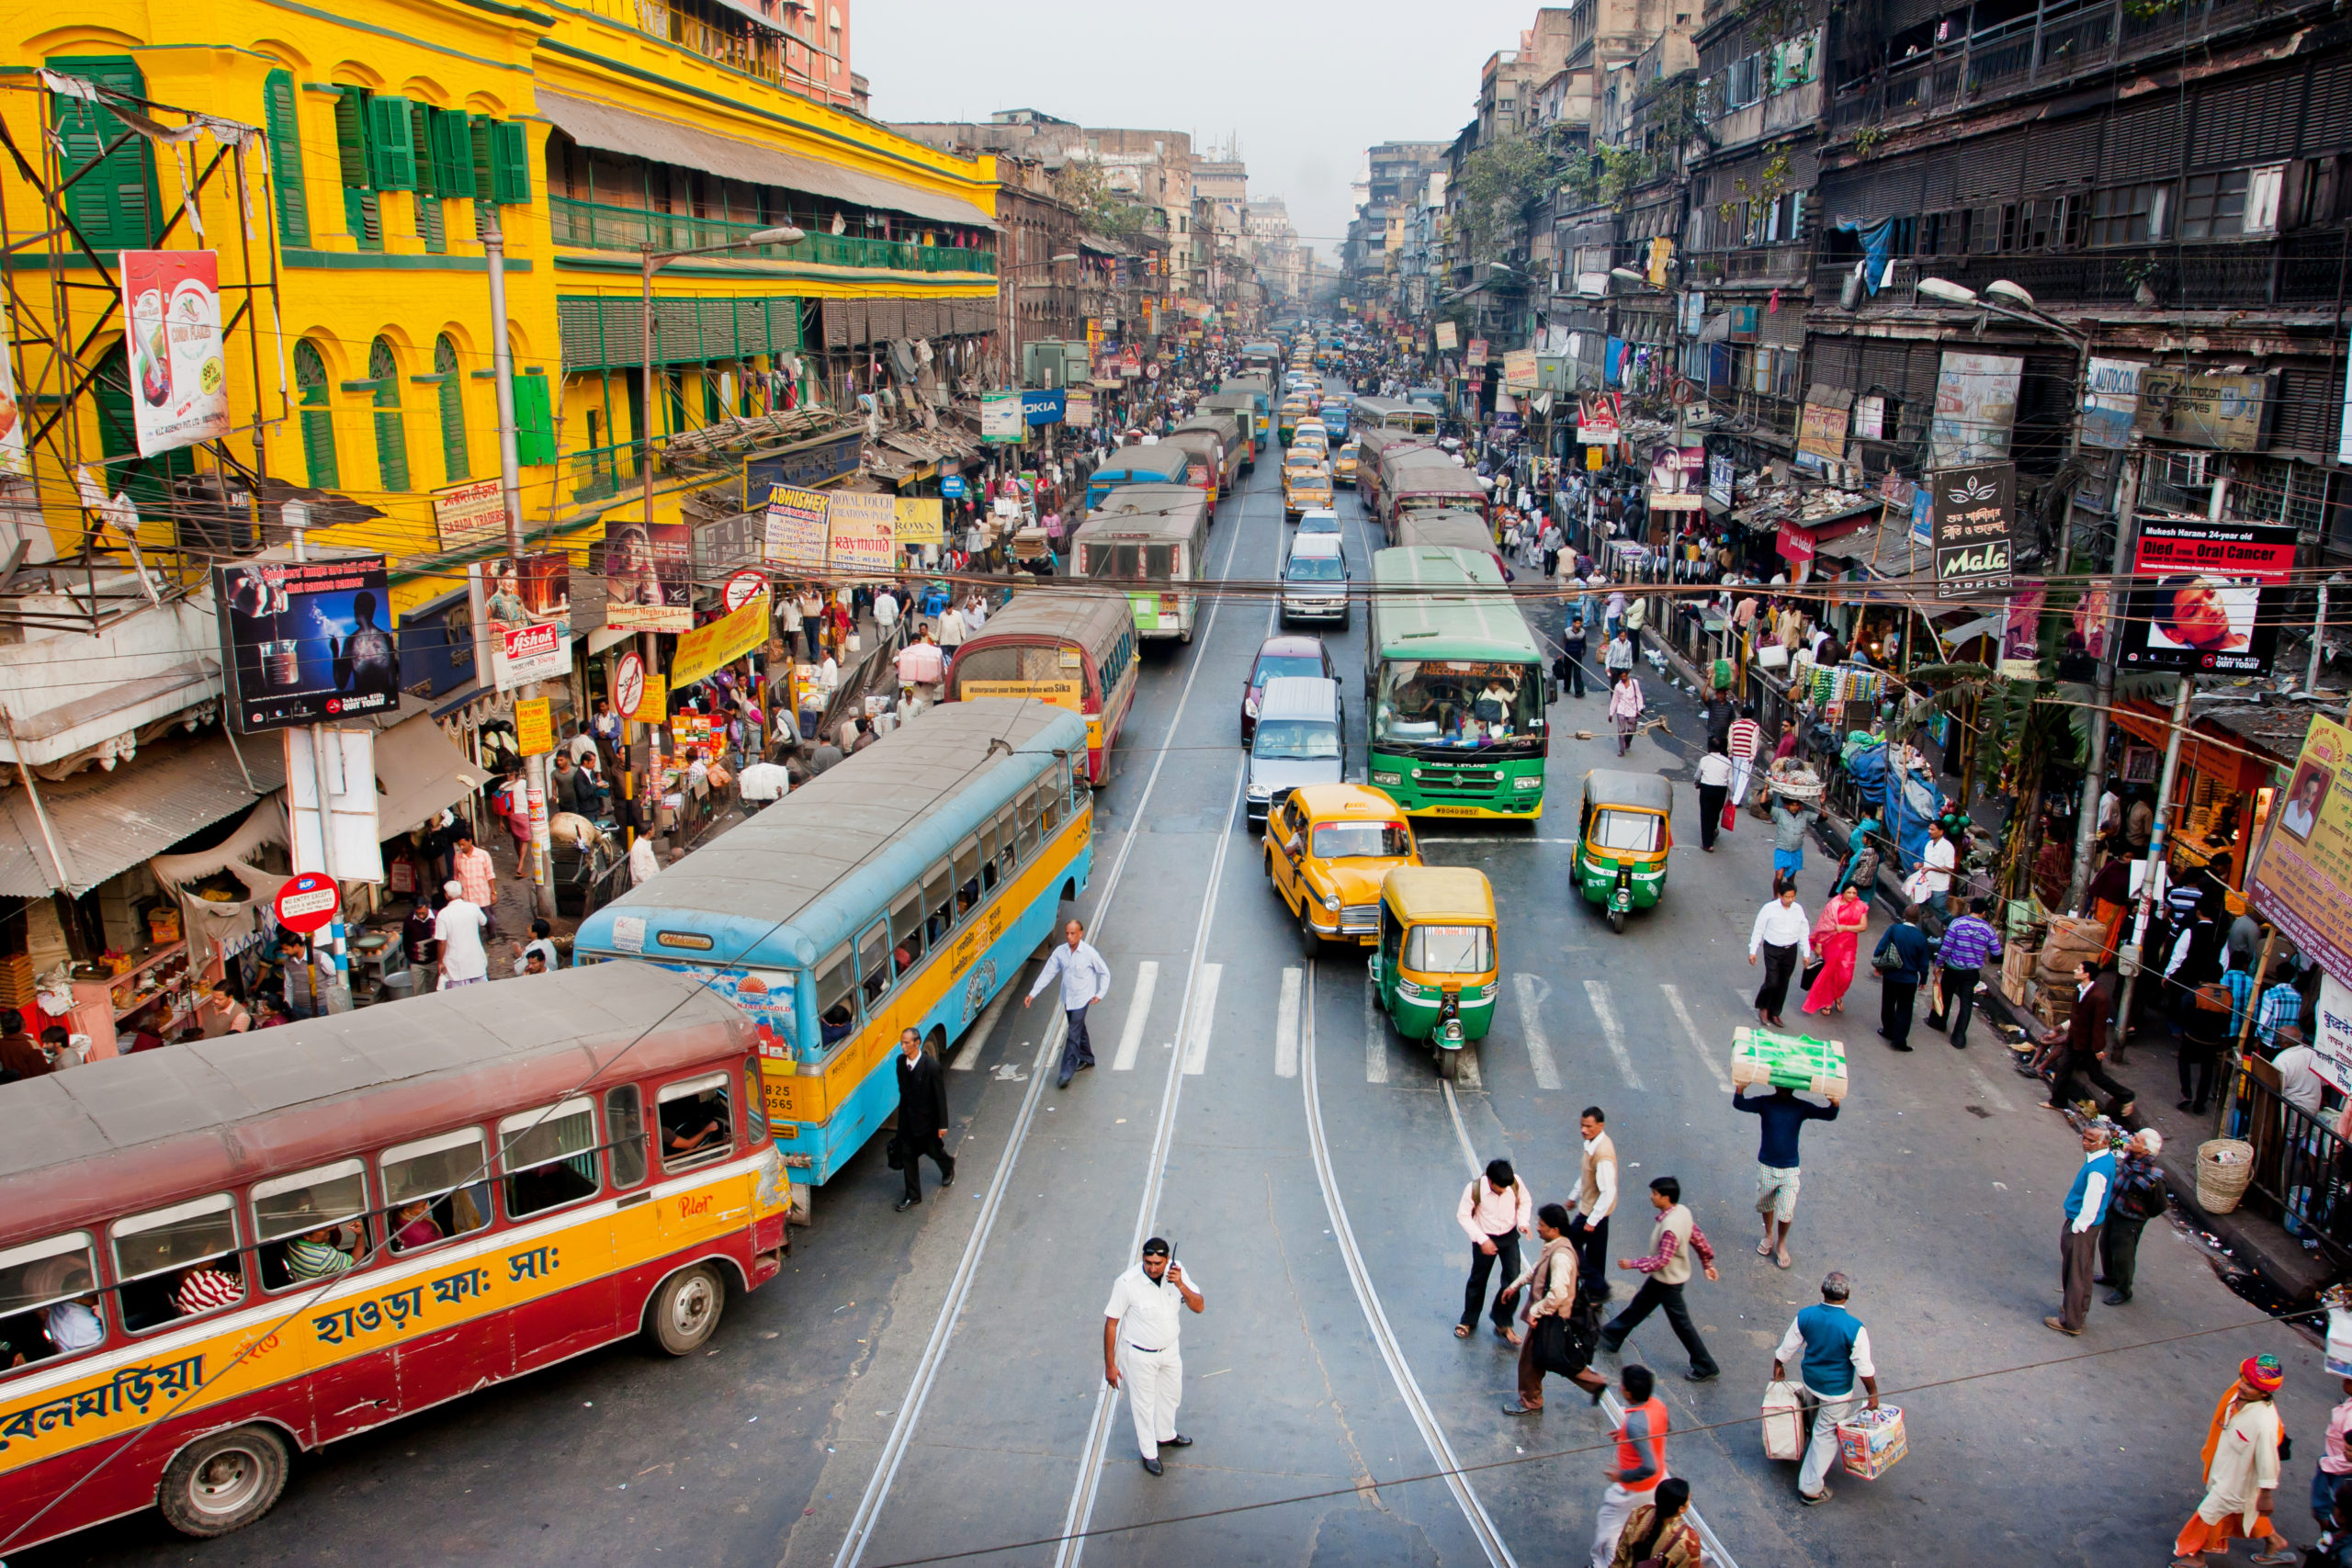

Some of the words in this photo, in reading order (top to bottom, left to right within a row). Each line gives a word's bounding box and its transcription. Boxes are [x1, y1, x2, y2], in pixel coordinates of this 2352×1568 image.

[1023, 400, 1057, 414] OKIA
[769, 486, 830, 514] ABHISHEK
[832, 493, 861, 506] ROYAL
[864, 495, 893, 510] TOUCH
[831, 508, 869, 519] CREATIONS
[443, 517, 473, 535] SARADA
[475, 509, 505, 526] TRADERS
[895, 519, 935, 530] ROWN
[2145, 526, 2177, 537] Mukesh
[2177, 528, 2206, 538] Harane
[2209, 530, 2239, 541] 24-year
[2240, 532, 2253, 541] old
[835, 536, 889, 554] Raymond
[2143, 540, 2174, 556] Died
[2197, 544, 2223, 558] Oral
[2227, 546, 2277, 561] Cancer
[1942, 544, 2008, 578] Mala
[303, 565, 327, 578] lungs
[286, 582, 303, 593] that
[304, 581, 334, 592] causes
[335, 578, 364, 589] cancer
[507, 627, 554, 655] Ashok
[2215, 660, 2233, 669] QUIT
[2234, 661, 2259, 670] TODAY
[1055, 683, 1070, 693] Sika
[343, 703, 361, 711] QUIT
[362, 698, 385, 709] TODAY
[294, 894, 311, 902] ENTRY
[311, 890, 331, 899] EXCEPT
[737, 1002, 763, 1011] NJALI
[2324, 1010, 2352, 1037] बुद्धदे
[311, 1285, 424, 1345] হাওড়া
